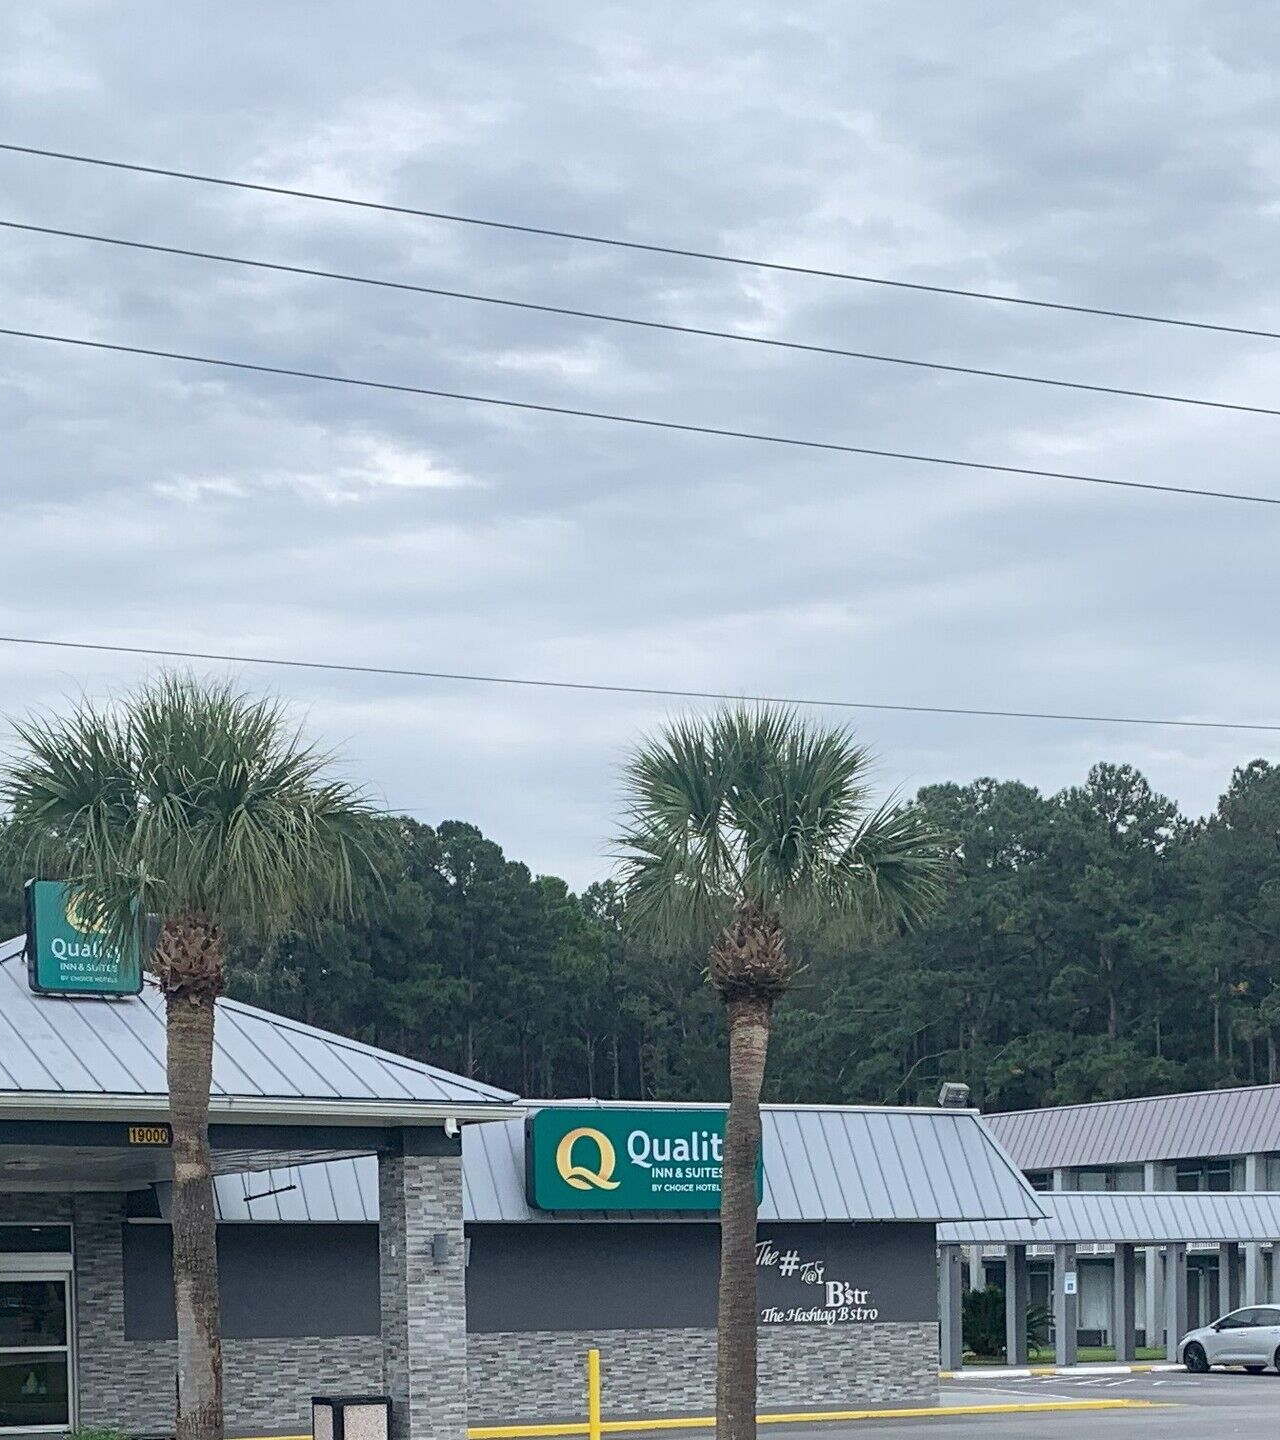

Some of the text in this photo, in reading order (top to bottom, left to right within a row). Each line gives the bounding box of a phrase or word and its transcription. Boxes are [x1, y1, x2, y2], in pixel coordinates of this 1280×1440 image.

[60, 962, 77, 971] INN
[78, 963, 84, 971] &
[132, 1128, 167, 1142] 19000
[627, 1129, 724, 1168] Qualit
[556, 1127, 621, 1191] Q
[651, 1167, 673, 1178] INN
[674, 1167, 683, 1178] &
[651, 1183, 722, 1192] BY CHOICE HOTEL
[755, 1239, 780, 1266] The
[760, 1306, 785, 1323] The
[785, 1306, 837, 1326] Hashtag
